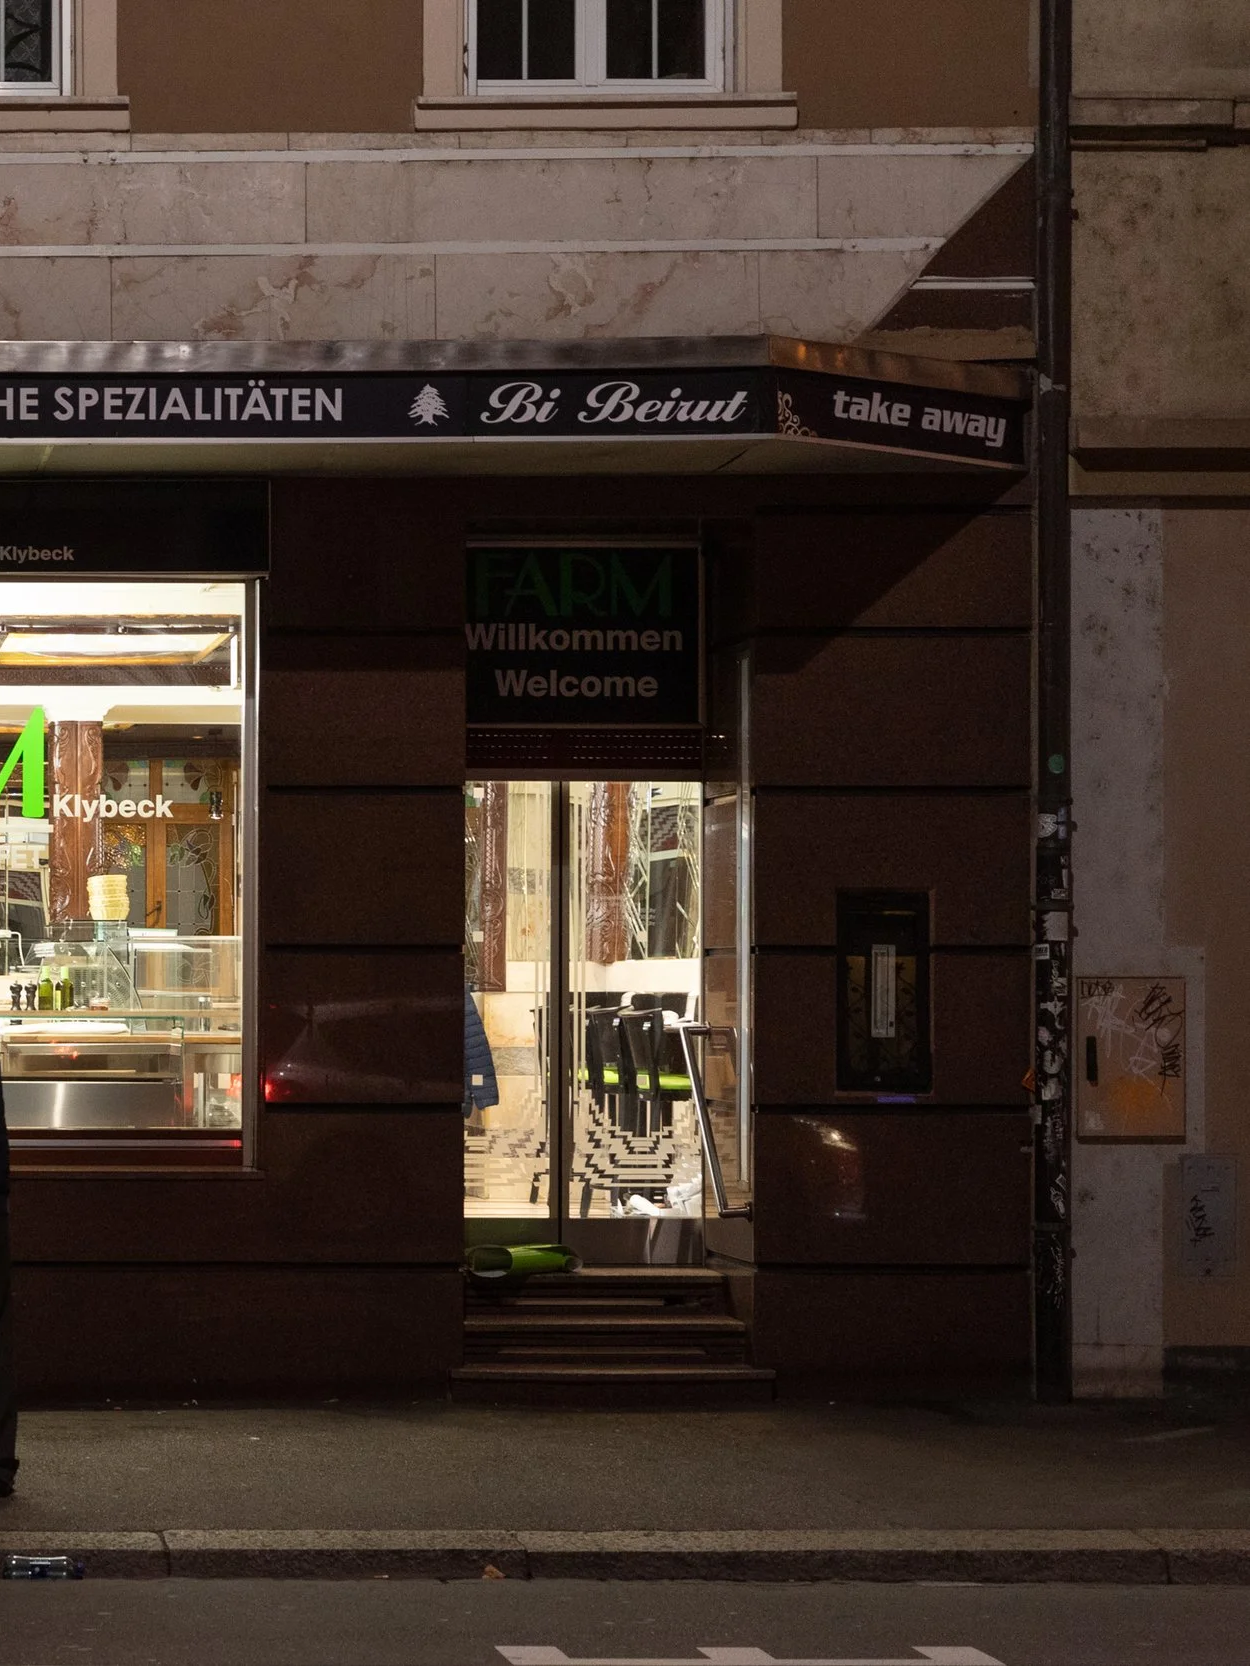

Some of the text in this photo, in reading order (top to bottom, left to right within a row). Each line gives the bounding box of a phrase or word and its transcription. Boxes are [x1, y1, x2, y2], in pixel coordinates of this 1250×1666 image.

[53, 380, 344, 422] SPEZIALITÄTEN
[480, 381, 749, 424] Bi Beirut
[833, 389, 1007, 448] take away
[0, 545, 75, 567] Klybeck
[475, 551, 675, 617] FARM
[465, 622, 684, 651] Willkommen
[494, 669, 660, 698] Welcome
[53, 794, 174, 823] Klybeck
